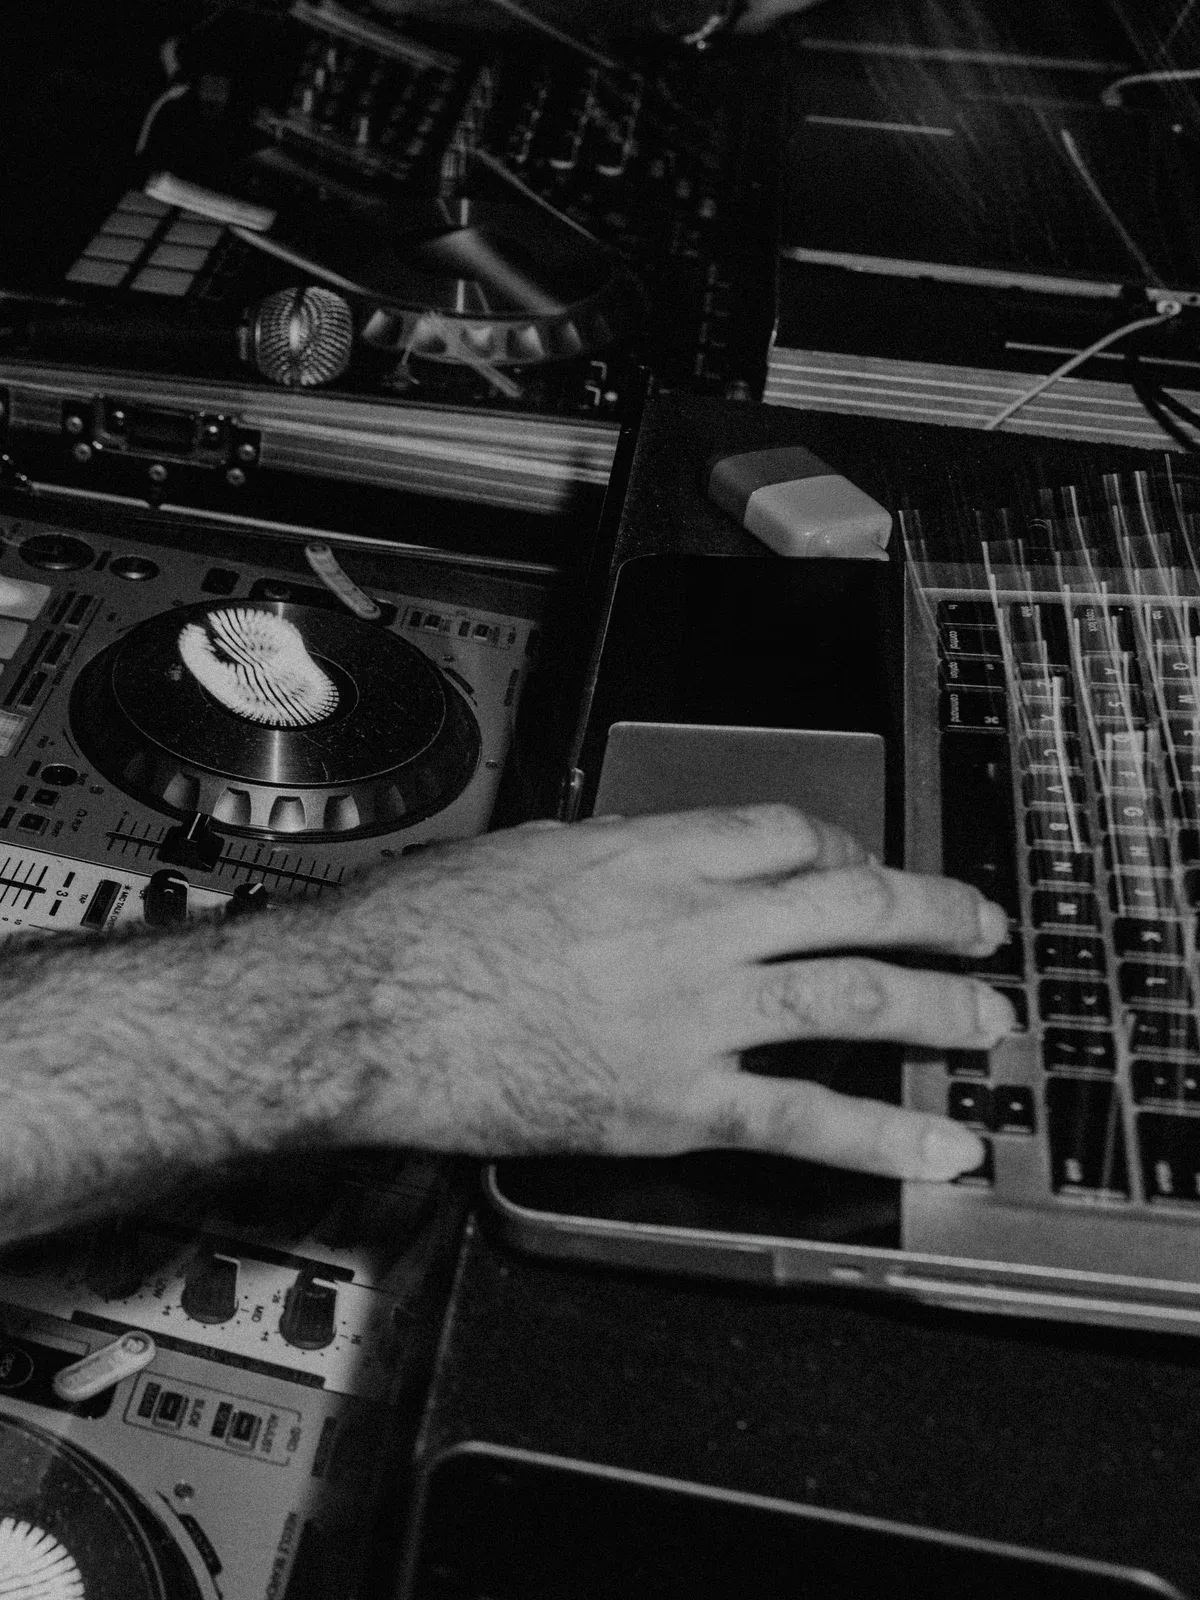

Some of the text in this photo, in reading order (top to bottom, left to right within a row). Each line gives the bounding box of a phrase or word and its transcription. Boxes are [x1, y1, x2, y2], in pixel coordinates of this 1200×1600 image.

[948, 630, 961, 649] control
[949, 661, 960, 680] option
[1104, 667, 1120, 676] A
[1174, 661, 1189, 671] Q
[1177, 692, 1195, 705] W
[950, 693, 961, 723] command
[1123, 806, 1144, 817] G
[1130, 846, 1149, 857] H
[1053, 861, 1073, 873] N
[55, 889, 69, 898] 3
[78, 893, 88, 905] TAP
[1141, 931, 1162, 942] K
[1146, 976, 1168, 986] L
[251, 1305, 265, 1323] MID
